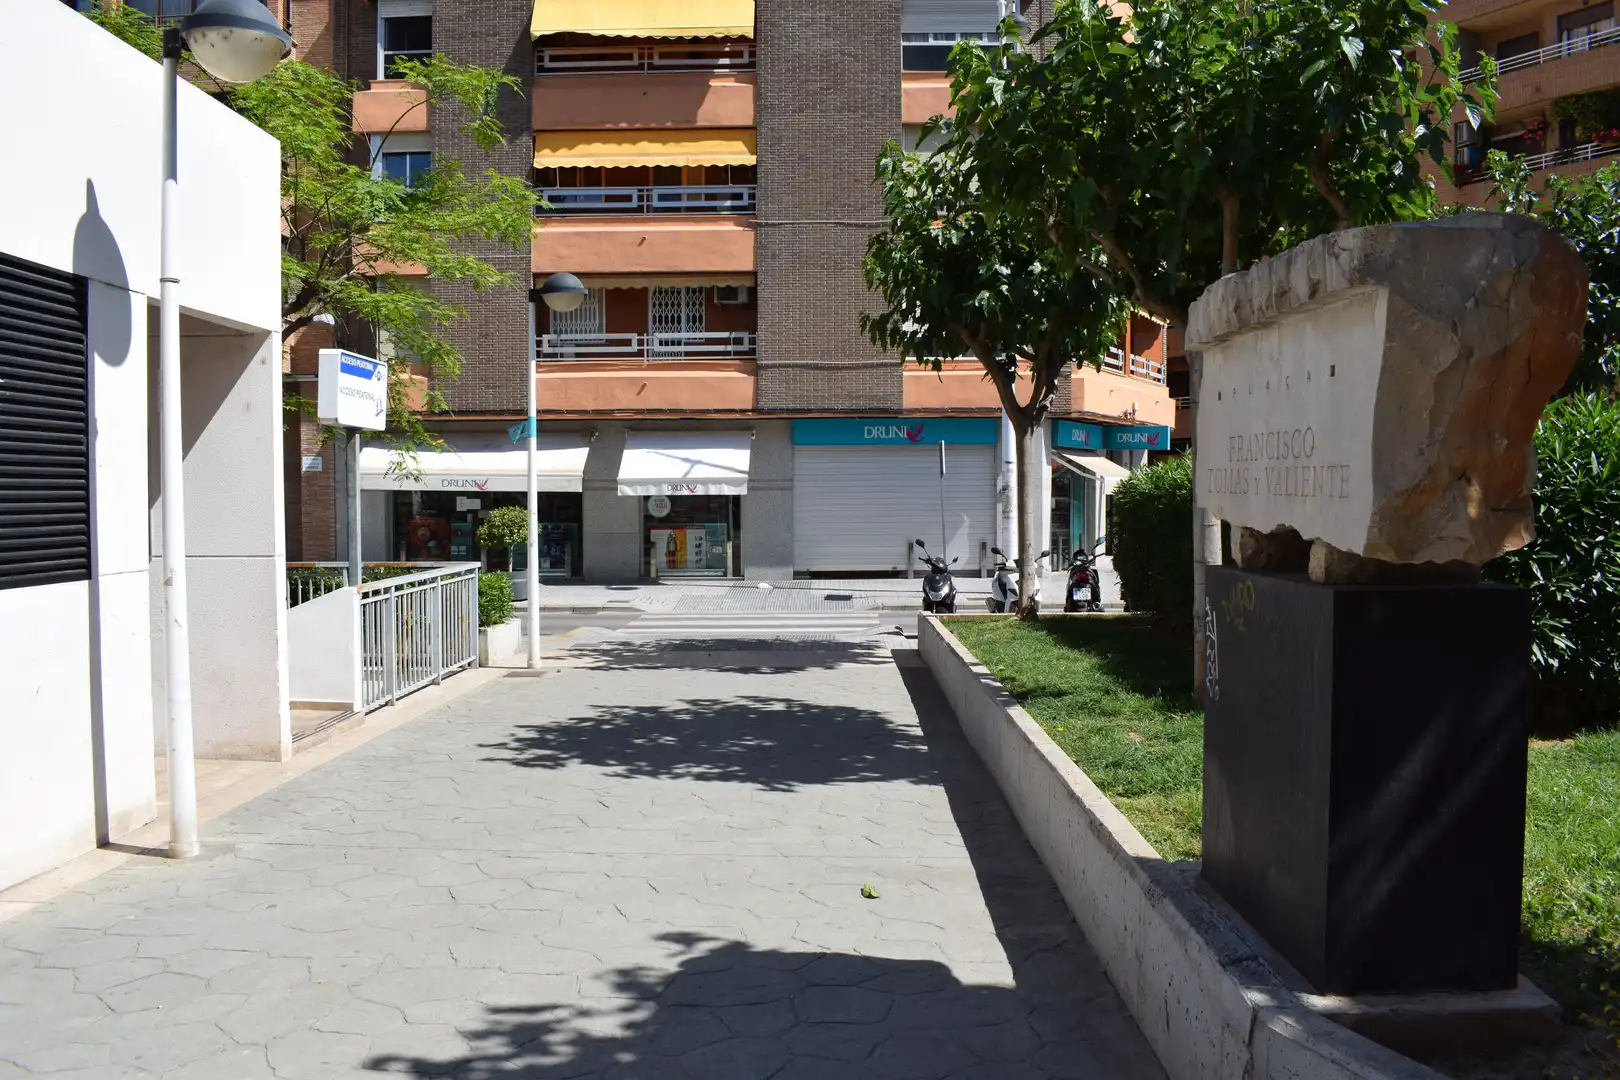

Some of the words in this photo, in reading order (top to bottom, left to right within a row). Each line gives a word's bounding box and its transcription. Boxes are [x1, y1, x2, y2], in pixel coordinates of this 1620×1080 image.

[341, 354, 356, 367] ACCESO
[357, 360, 375, 371] PEATONAL
[1232, 369, 1312, 398] PLAÇA
[339, 386, 356, 397] ACCESO
[356, 389, 375, 401] PEATONAL
[864, 425, 908, 439] DRUNI
[1117, 432, 1148, 443] DRUNI
[1228, 426, 1315, 463] FRANCISCO
[441, 479, 478, 488] DRUNI
[1207, 467, 1250, 495] TOMAS
[1265, 464, 1351, 499] VALIENTE
